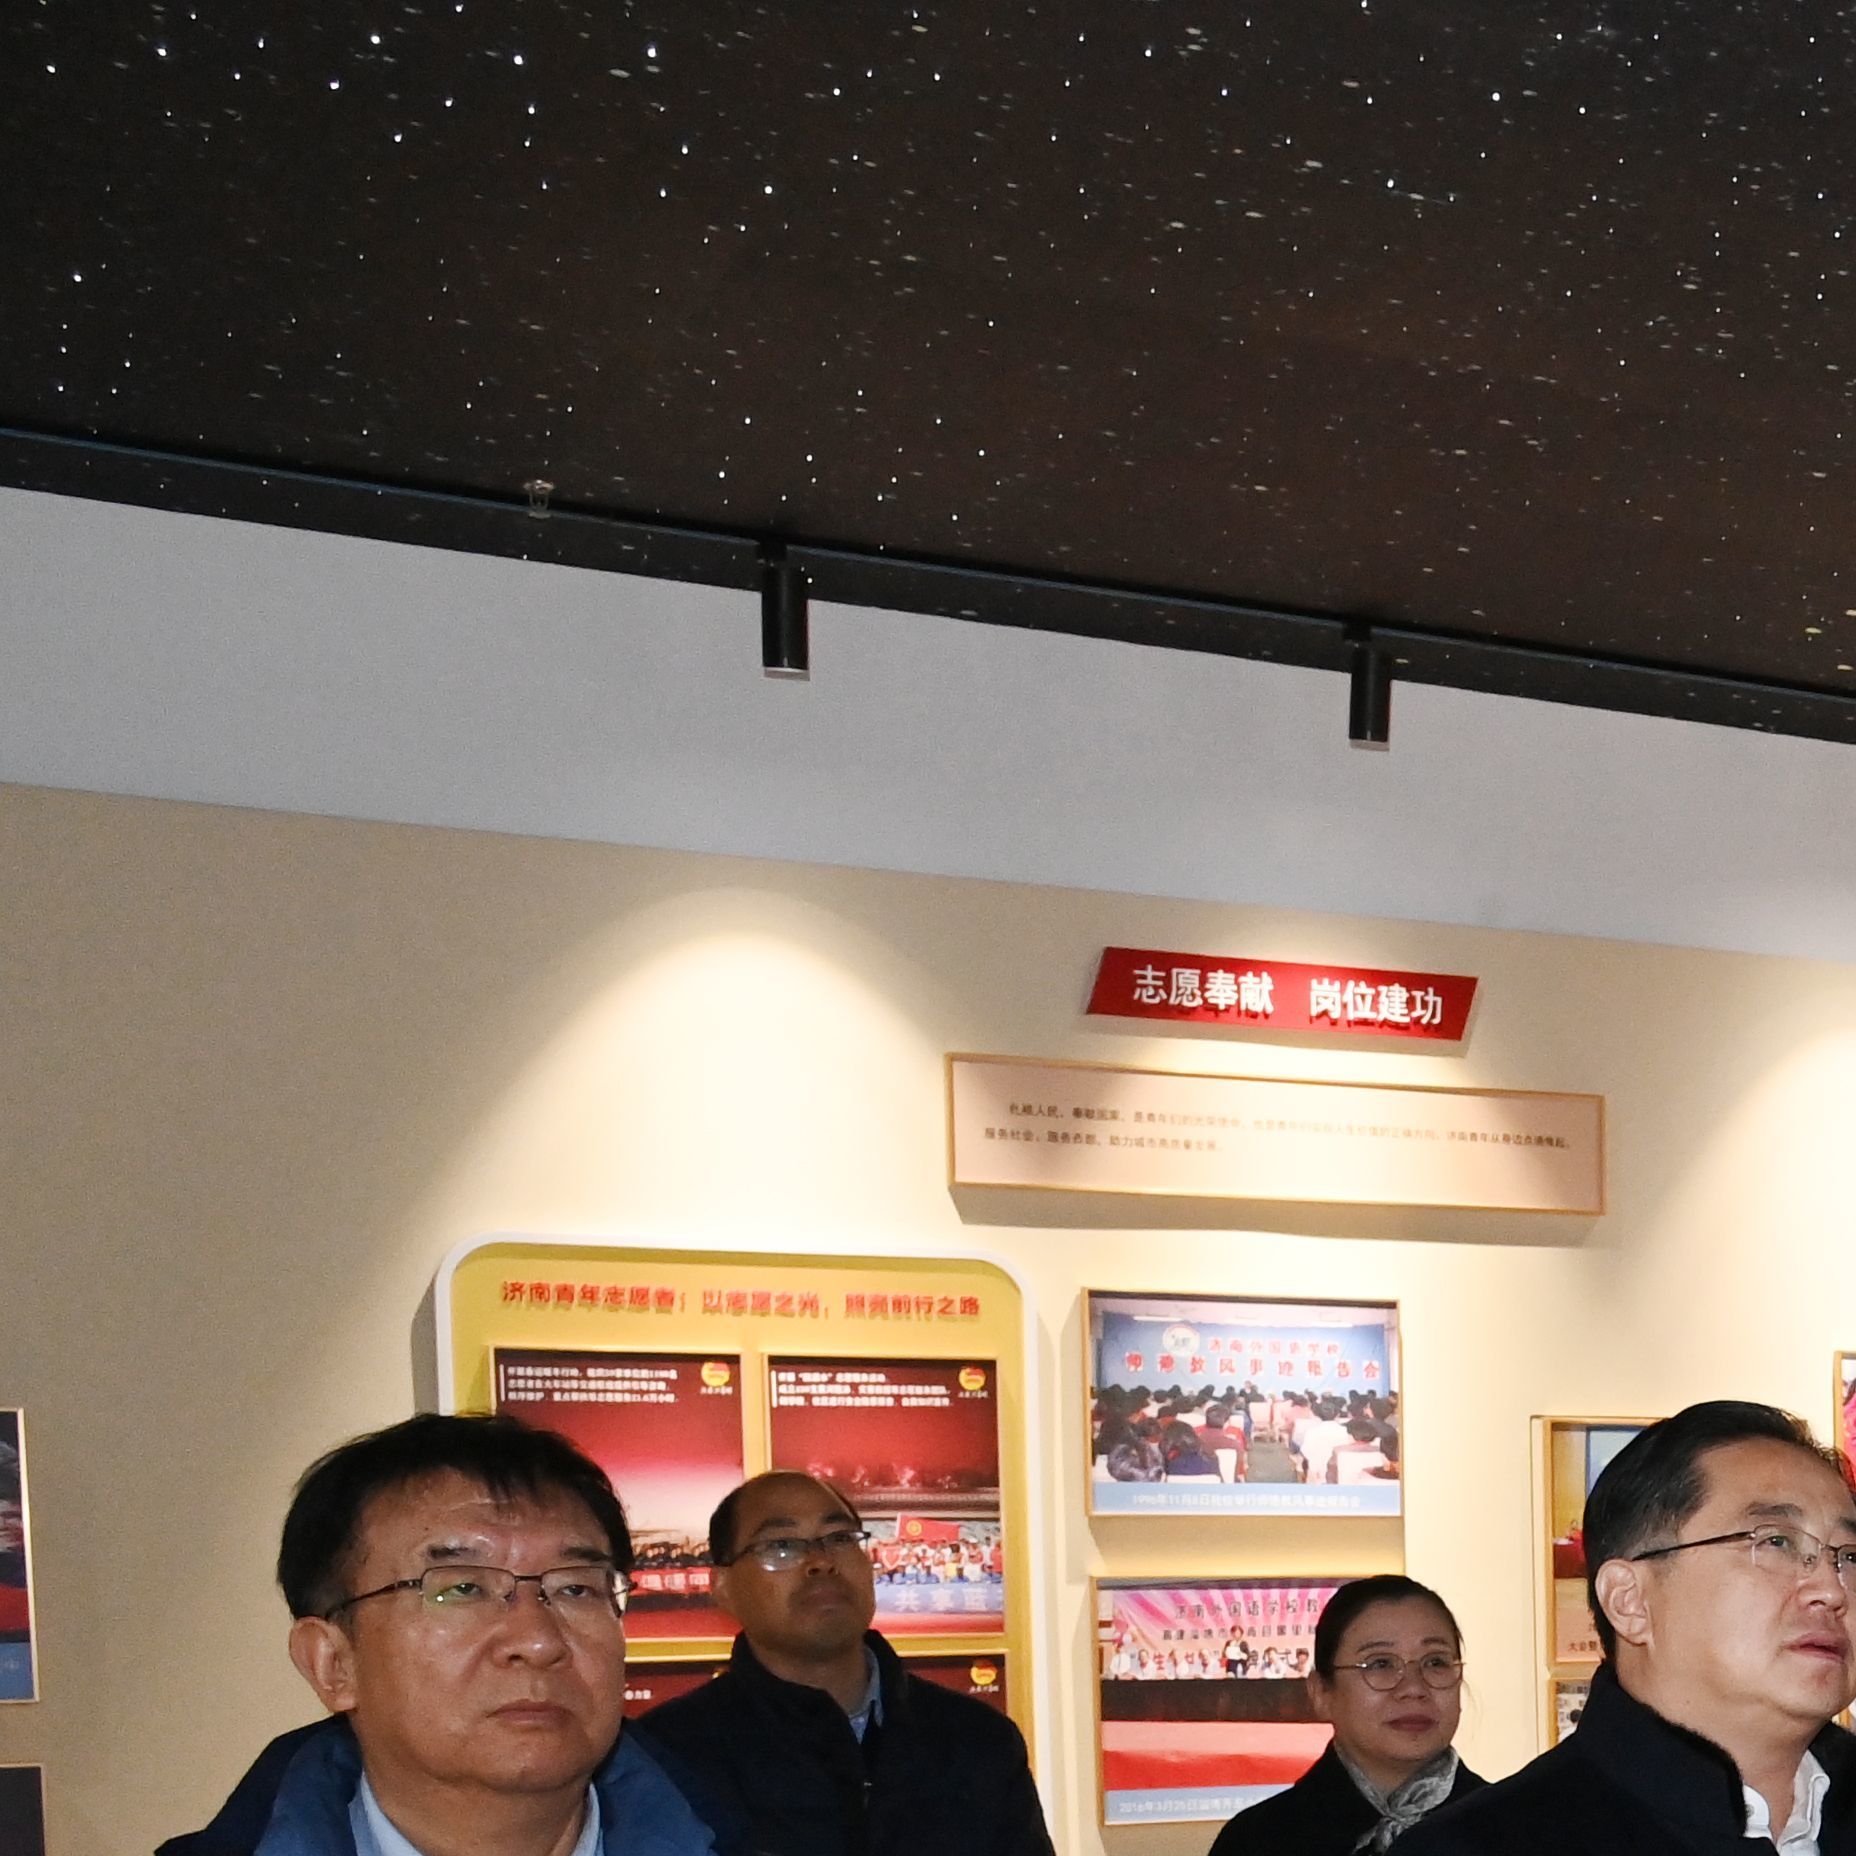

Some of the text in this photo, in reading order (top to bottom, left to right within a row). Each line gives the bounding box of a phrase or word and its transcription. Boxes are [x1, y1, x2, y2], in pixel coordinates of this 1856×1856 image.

[1132, 964, 1444, 1026] 志愿奉献 岗位建功
